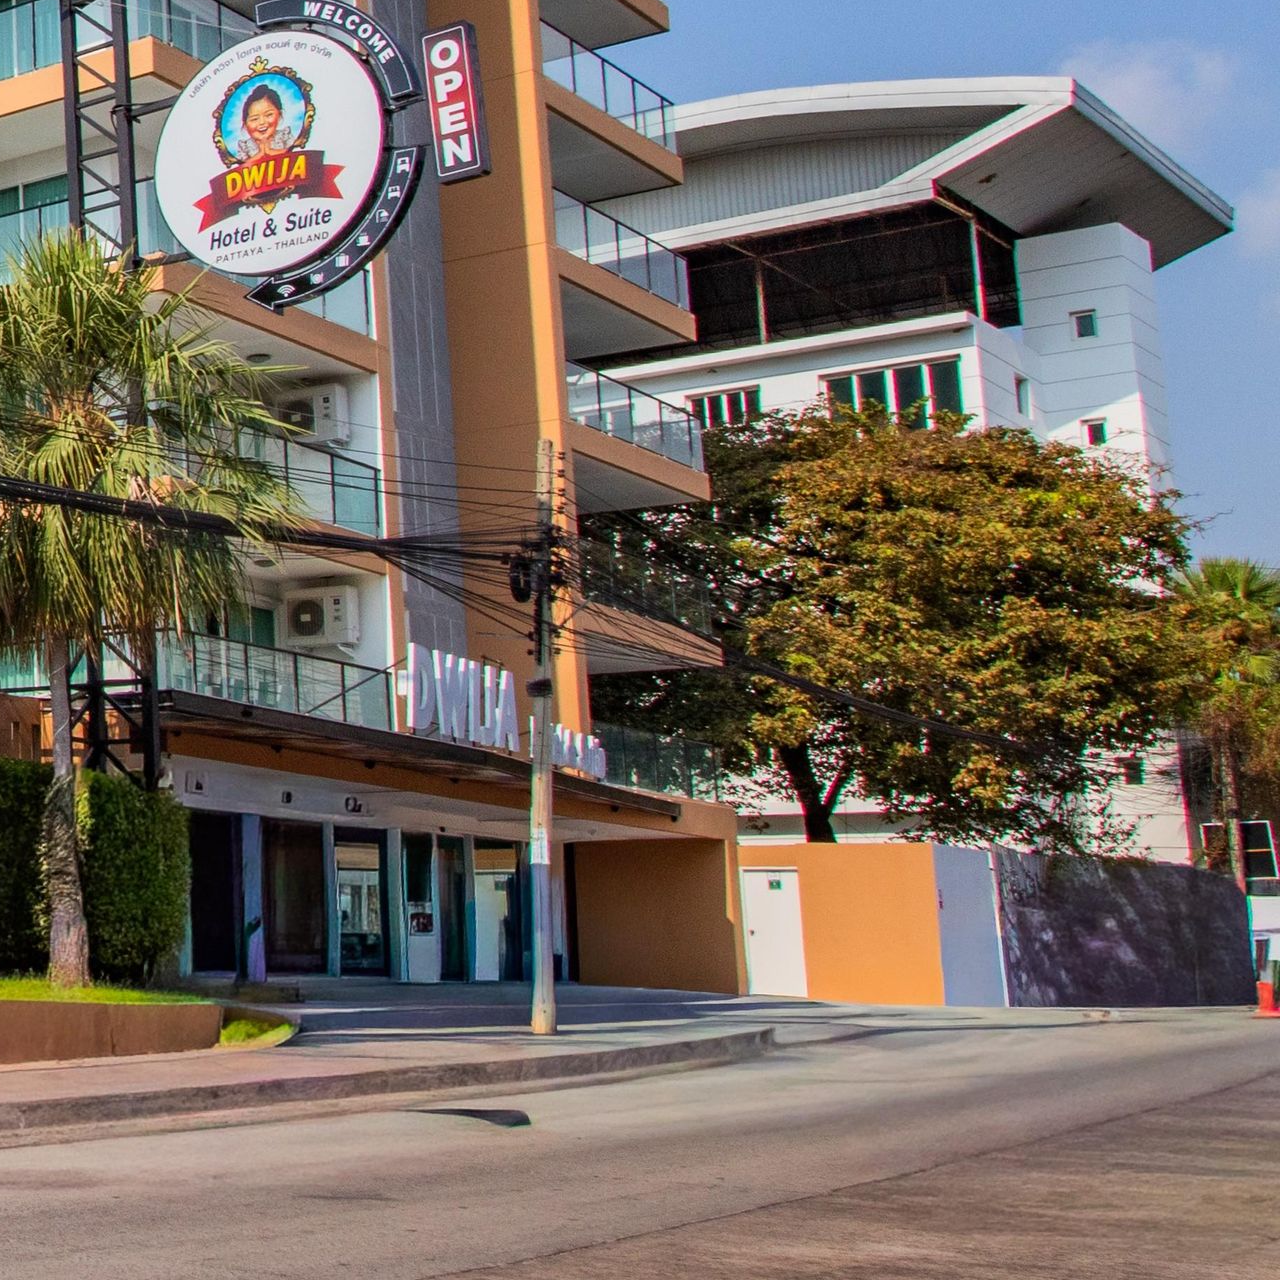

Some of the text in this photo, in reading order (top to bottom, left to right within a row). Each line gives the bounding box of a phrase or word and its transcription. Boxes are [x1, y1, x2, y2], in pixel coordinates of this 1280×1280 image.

[303, 1, 395, 64] WELCOME
[430, 39, 473, 168] OPEN
[225, 154, 307, 199] DWIJA
[210, 207, 332, 251] Hotel & Suite
[215, 246, 264, 264] PATTAYA
[274, 231, 330, 251] THAILAND
[406, 642, 520, 753] DWIJA
